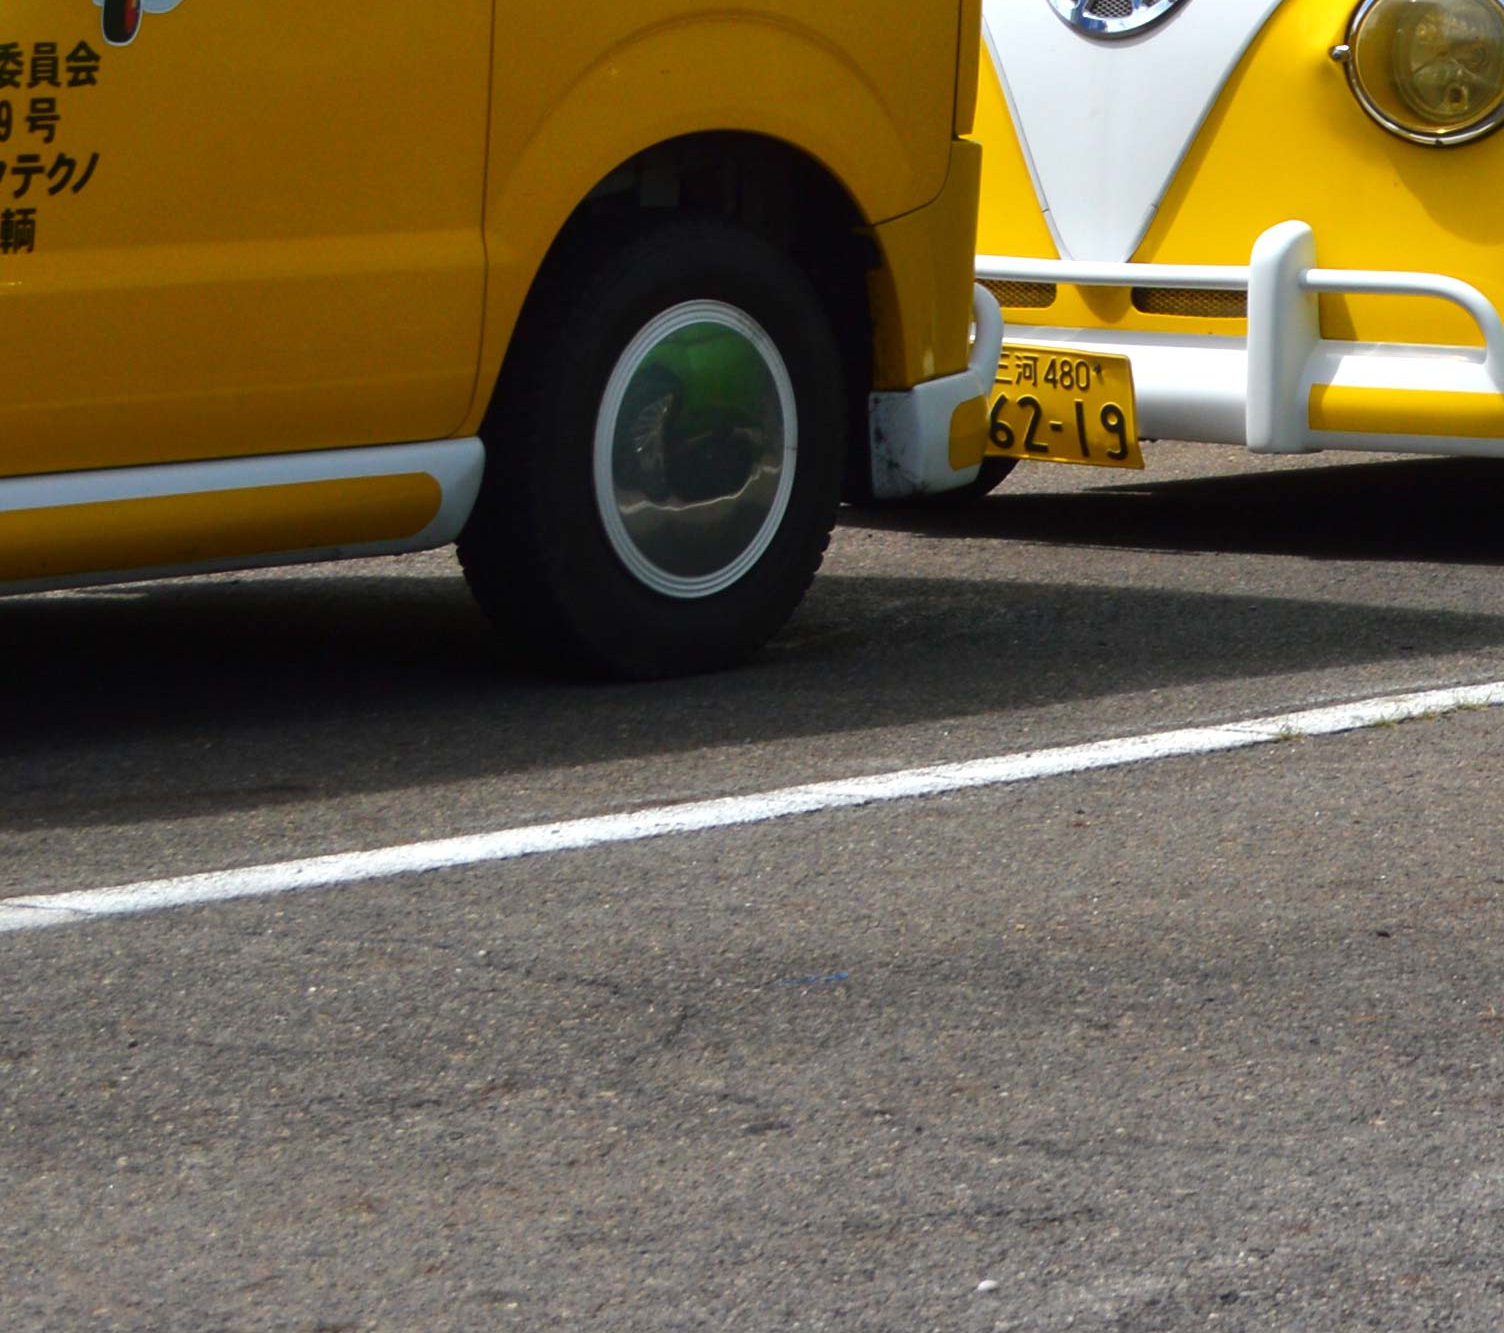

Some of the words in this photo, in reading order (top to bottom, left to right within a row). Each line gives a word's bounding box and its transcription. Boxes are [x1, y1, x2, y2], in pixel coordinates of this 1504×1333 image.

[0, 41, 102, 88] 委員会
[1044, 358, 1090, 390] 480
[989, 394, 1129, 460] 62-19
